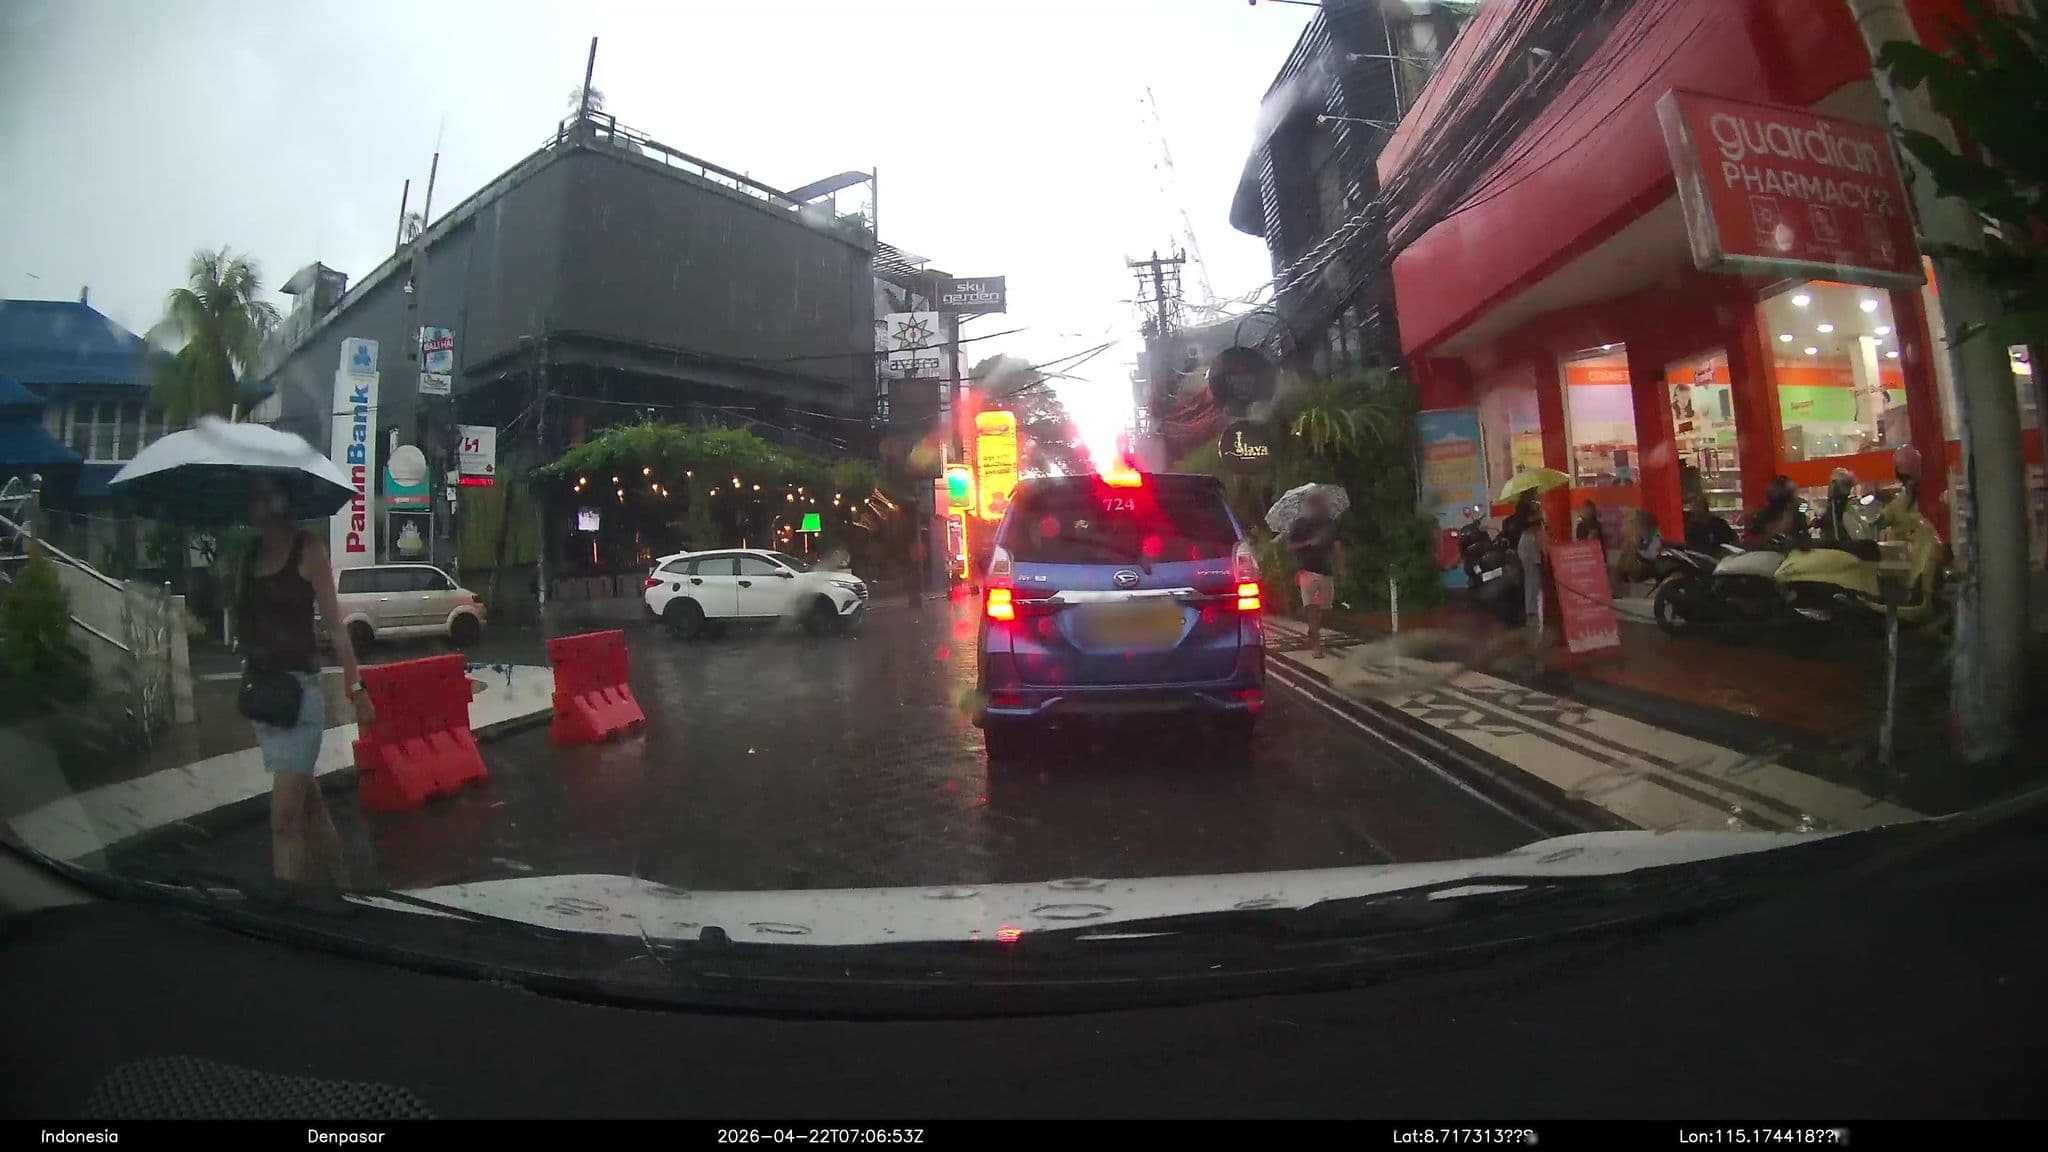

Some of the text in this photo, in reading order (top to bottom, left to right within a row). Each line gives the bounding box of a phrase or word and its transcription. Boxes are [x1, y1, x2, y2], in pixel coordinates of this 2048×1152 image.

[1710, 113, 1883, 176] guardian
[1721, 161, 1871, 210] PHARMACY
[957, 281, 984, 293] sky
[943, 292, 999, 304] garden
[1103, 497, 1136, 511] 724
